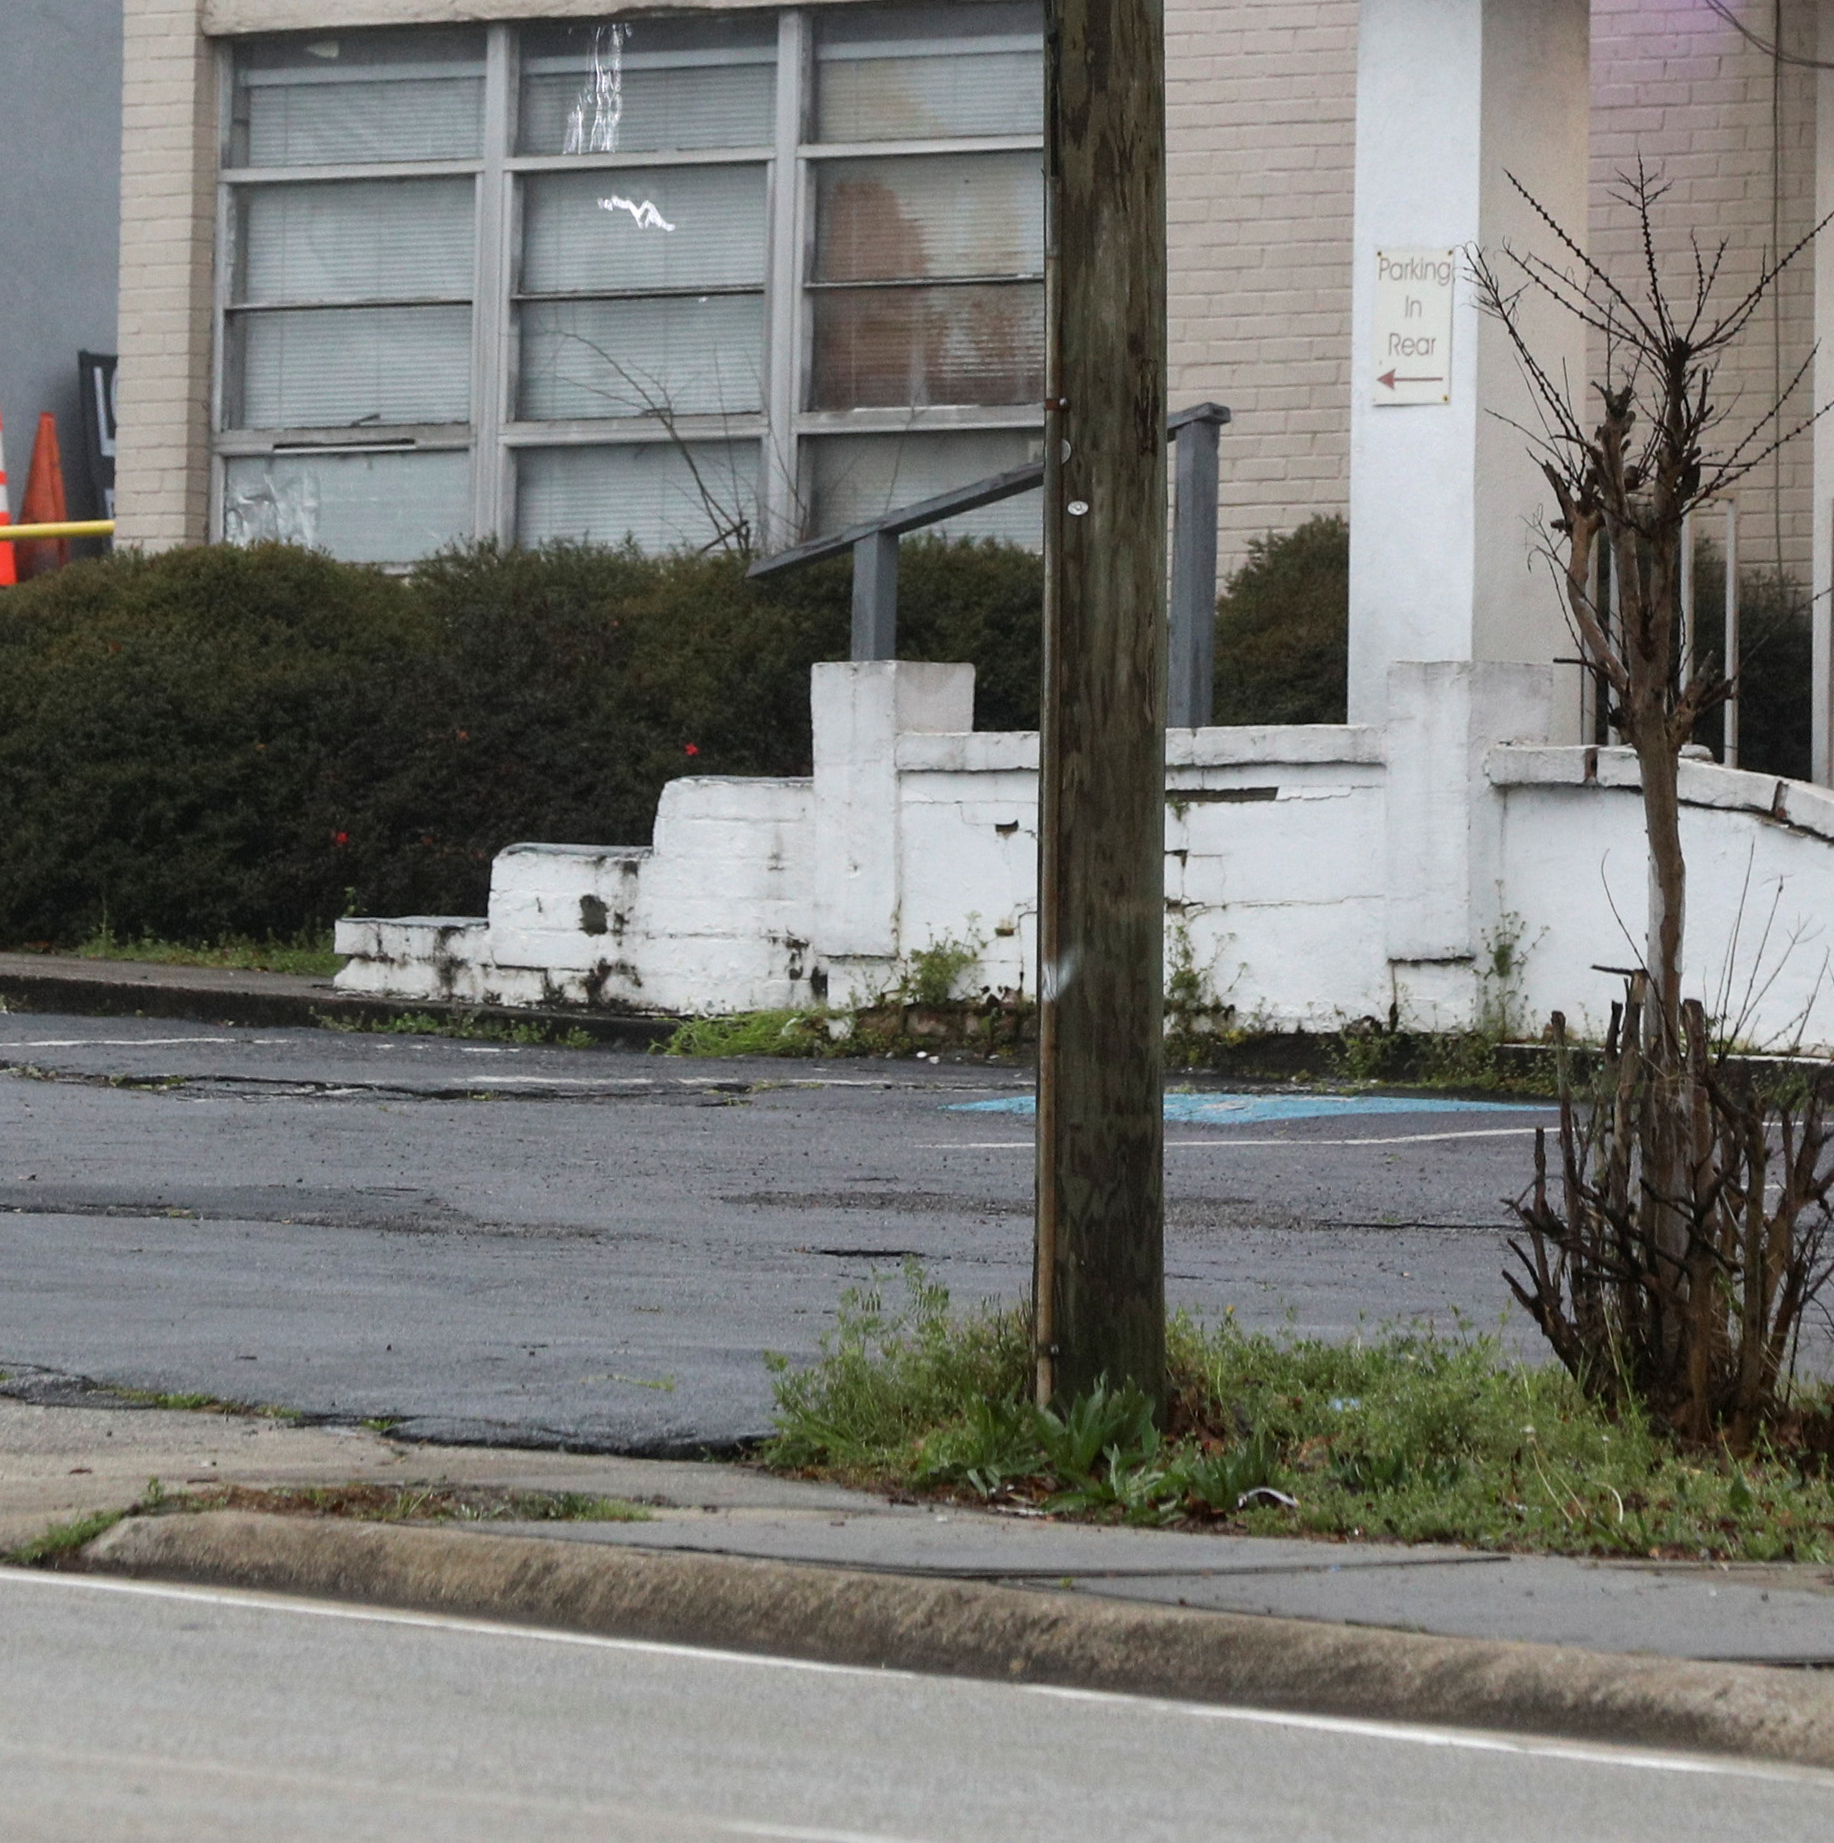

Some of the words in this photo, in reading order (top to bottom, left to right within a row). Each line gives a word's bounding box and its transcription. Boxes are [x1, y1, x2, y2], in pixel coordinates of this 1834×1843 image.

[1377, 257, 1452, 287] Parking
[1403, 295, 1423, 318] In
[1387, 332, 1437, 357] Rear
